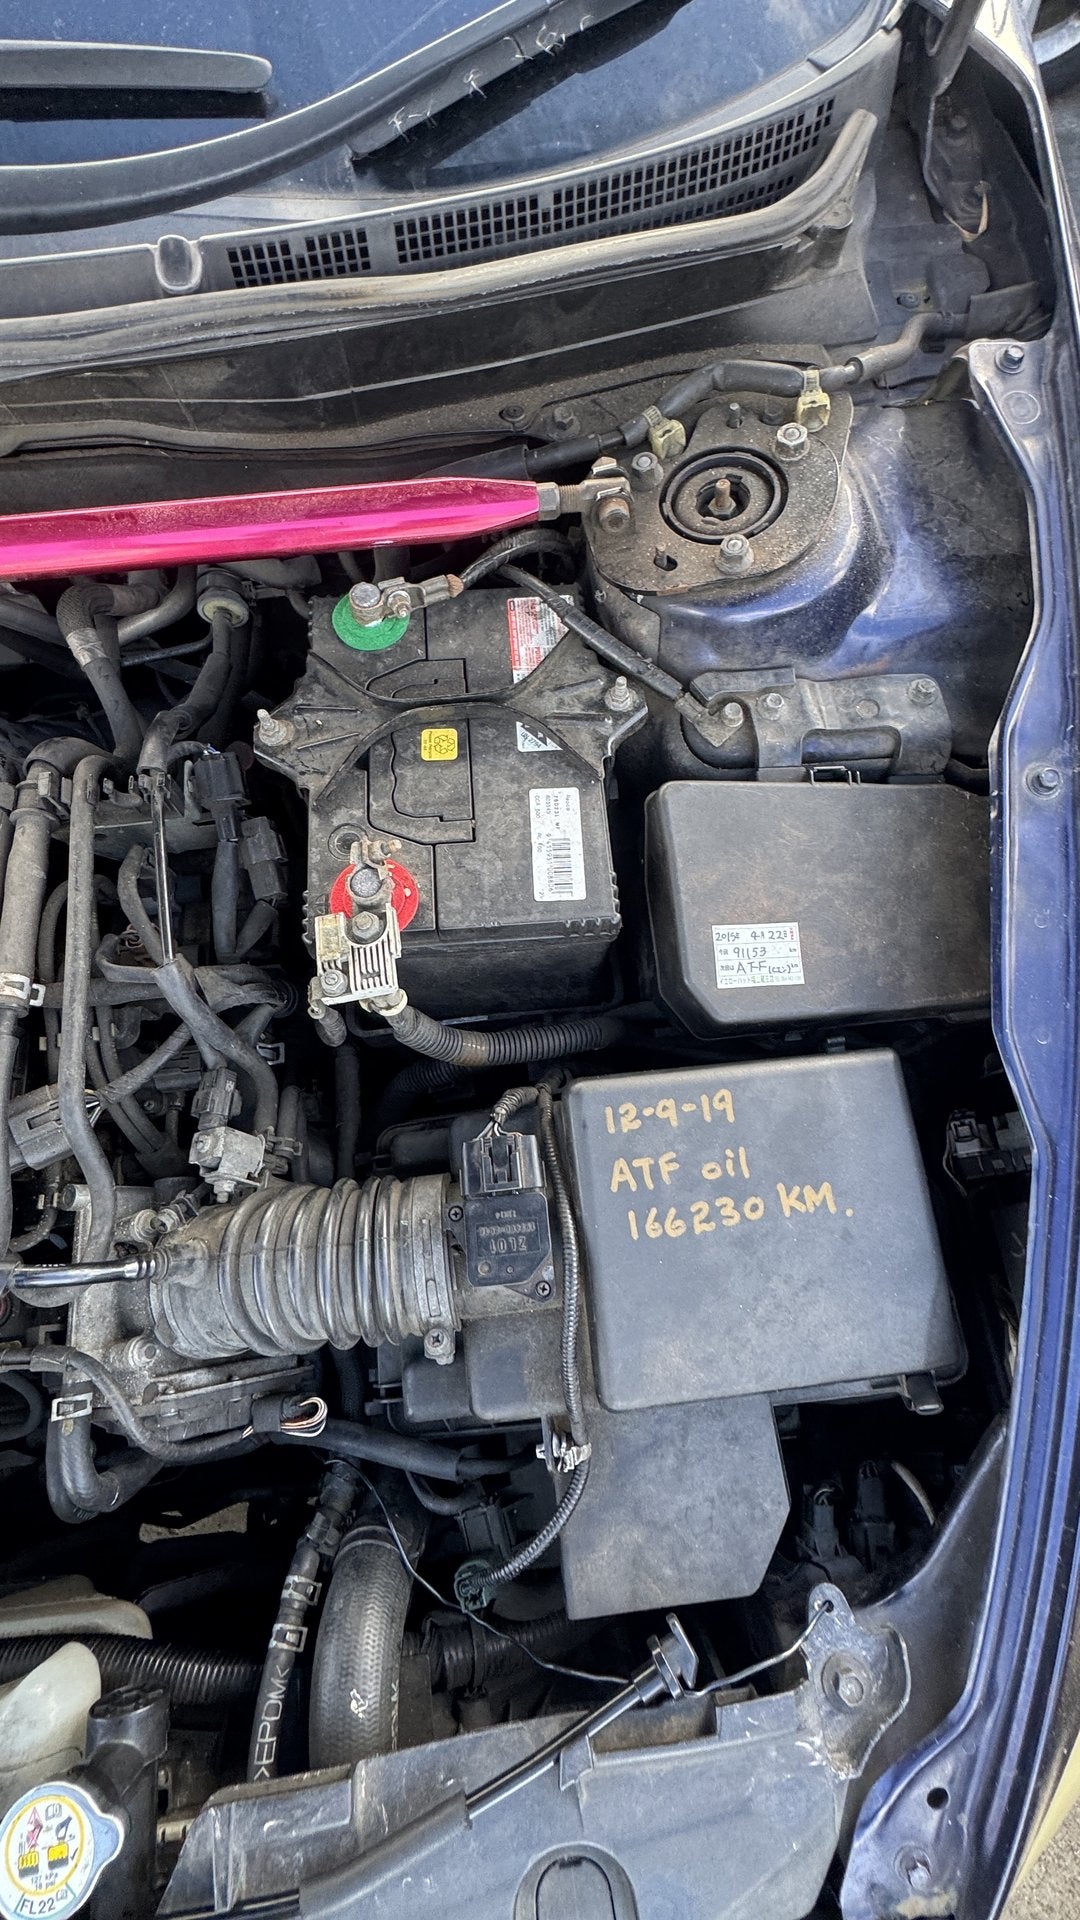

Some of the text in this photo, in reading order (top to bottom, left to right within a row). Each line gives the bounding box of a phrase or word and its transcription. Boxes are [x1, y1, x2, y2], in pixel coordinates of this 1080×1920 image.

[737, 960, 767, 975] ATF
[611, 1146, 750, 1193] ATF oil
[628, 1196, 765, 1240] 166230
[20, 1897, 56, 1915] FL22
